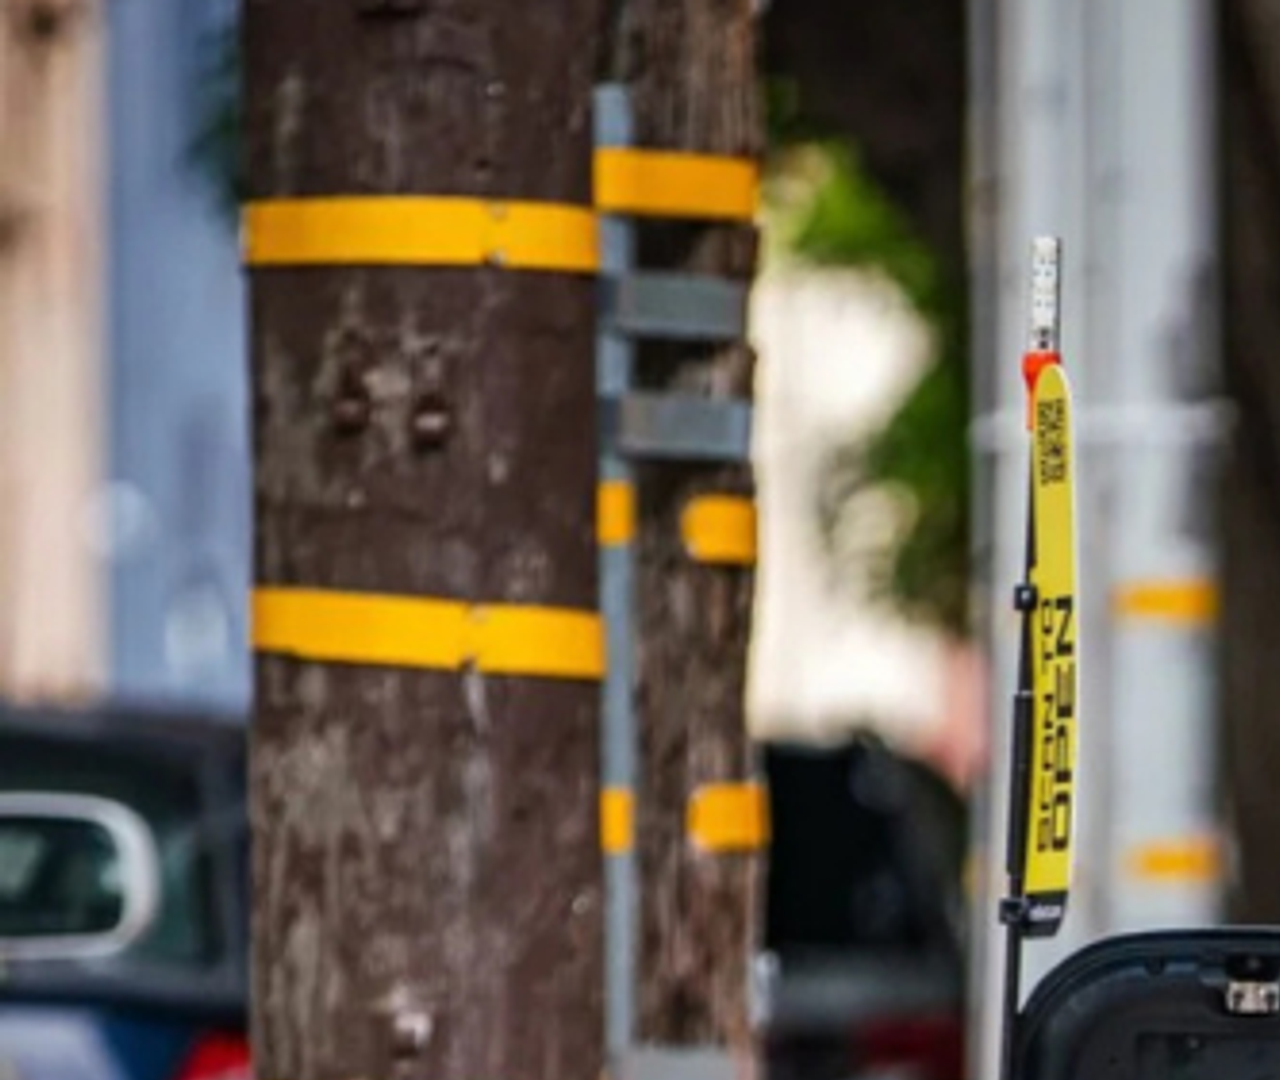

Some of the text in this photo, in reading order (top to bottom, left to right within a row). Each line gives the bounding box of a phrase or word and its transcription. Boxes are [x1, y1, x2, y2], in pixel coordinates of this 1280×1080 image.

[1037, 597, 1055, 852] SCAN TO
[1052, 595, 1075, 852] OPEN
